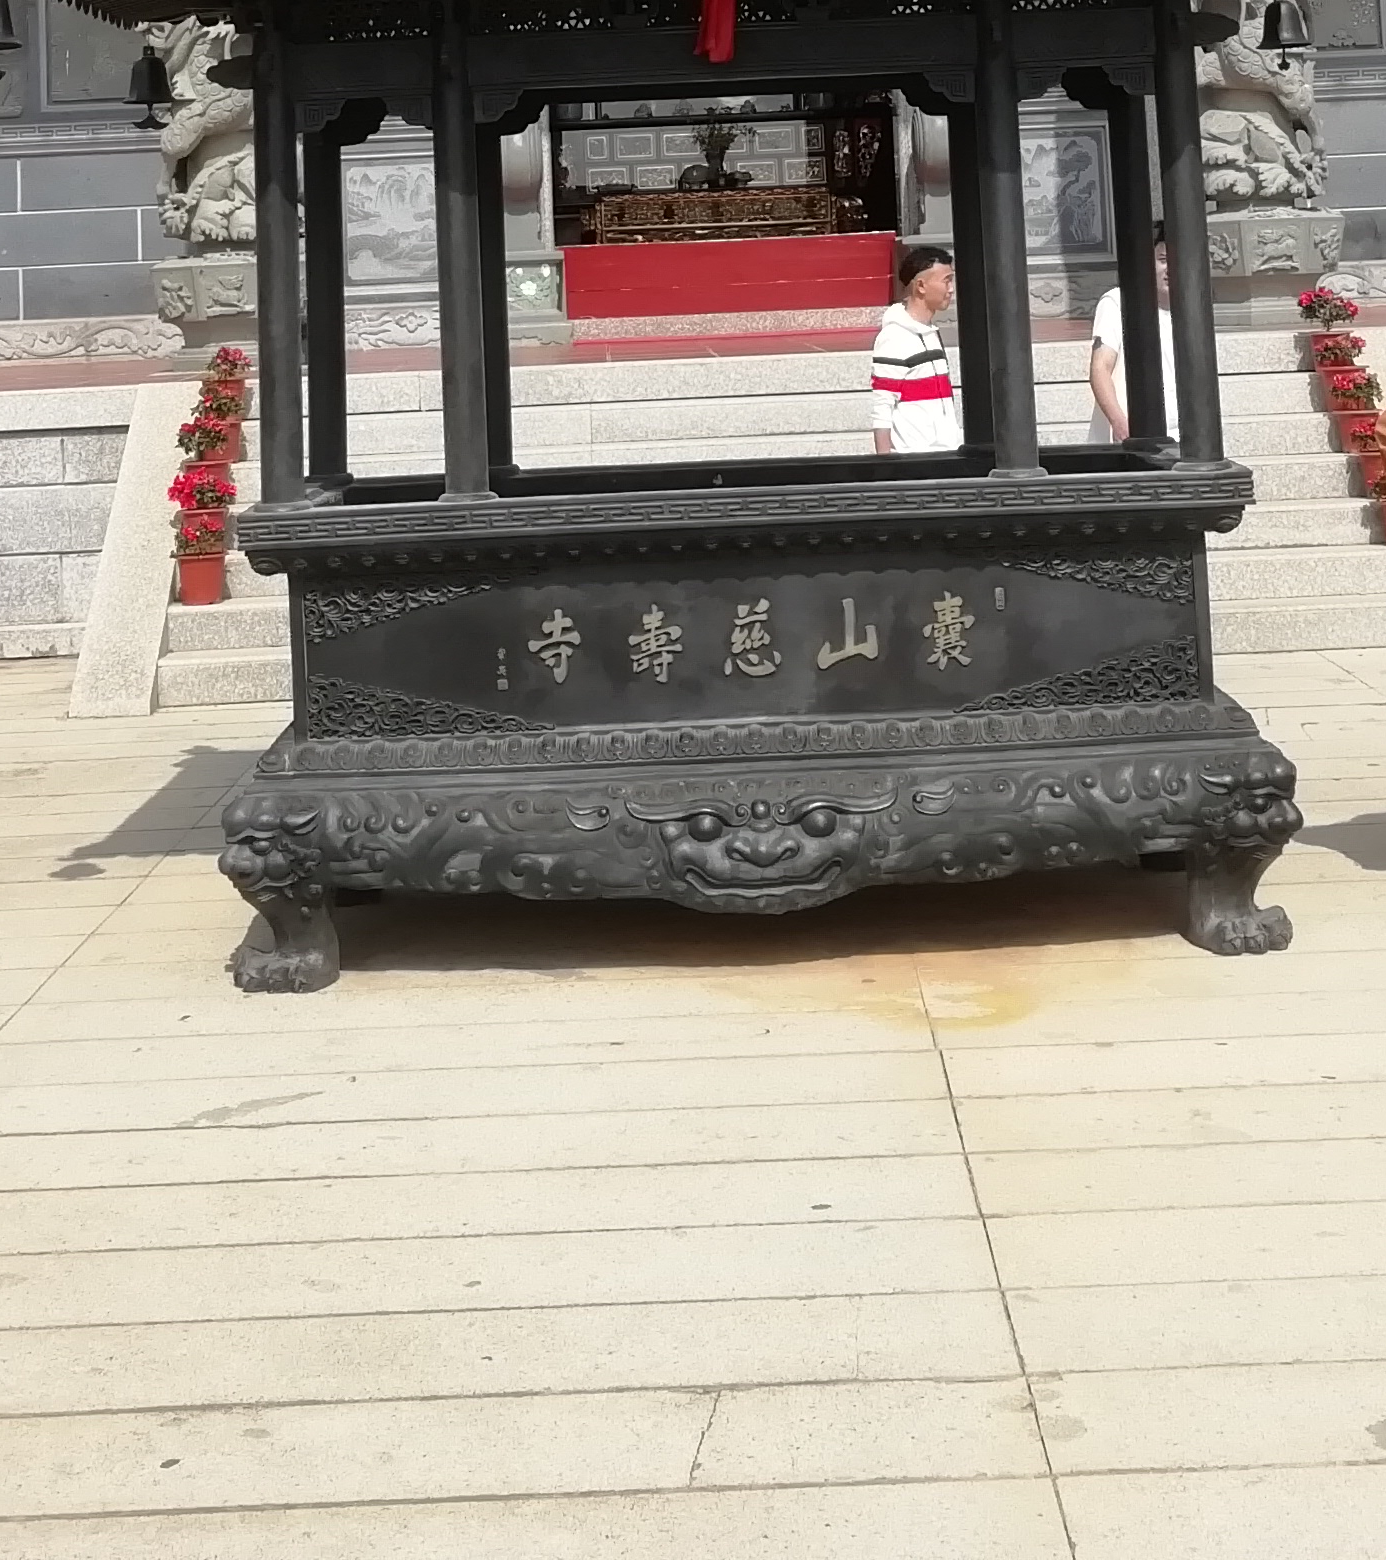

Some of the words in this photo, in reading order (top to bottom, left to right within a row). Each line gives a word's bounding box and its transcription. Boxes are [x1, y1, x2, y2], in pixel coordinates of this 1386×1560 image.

[528, 591, 975, 684] 囊山慈壽寺
